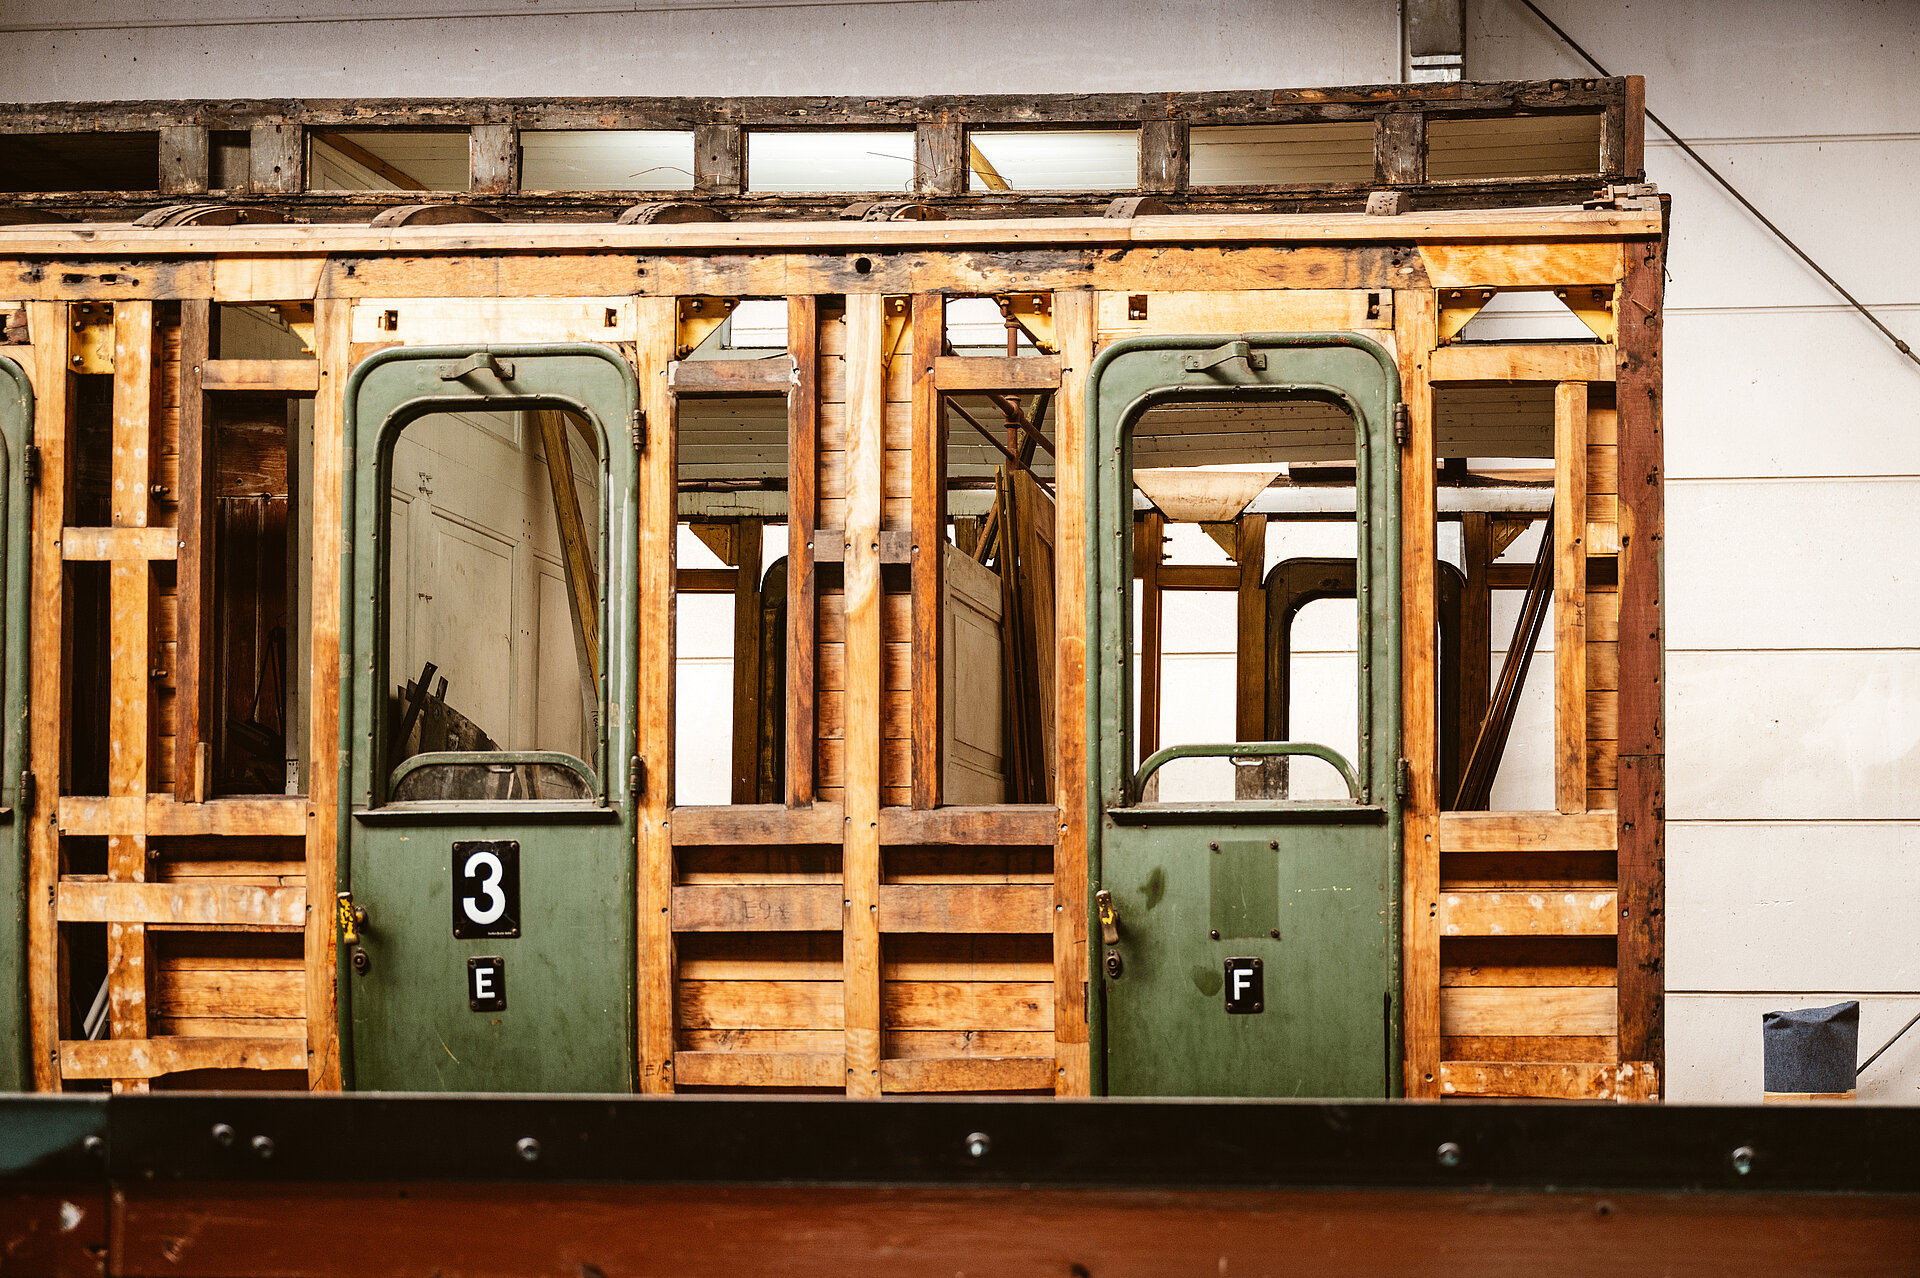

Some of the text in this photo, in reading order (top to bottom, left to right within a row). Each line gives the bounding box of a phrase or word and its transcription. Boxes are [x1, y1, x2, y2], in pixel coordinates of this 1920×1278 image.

[463, 851, 506, 925] 3
[475, 967, 496, 999] E
[1233, 969, 1254, 1001] F
